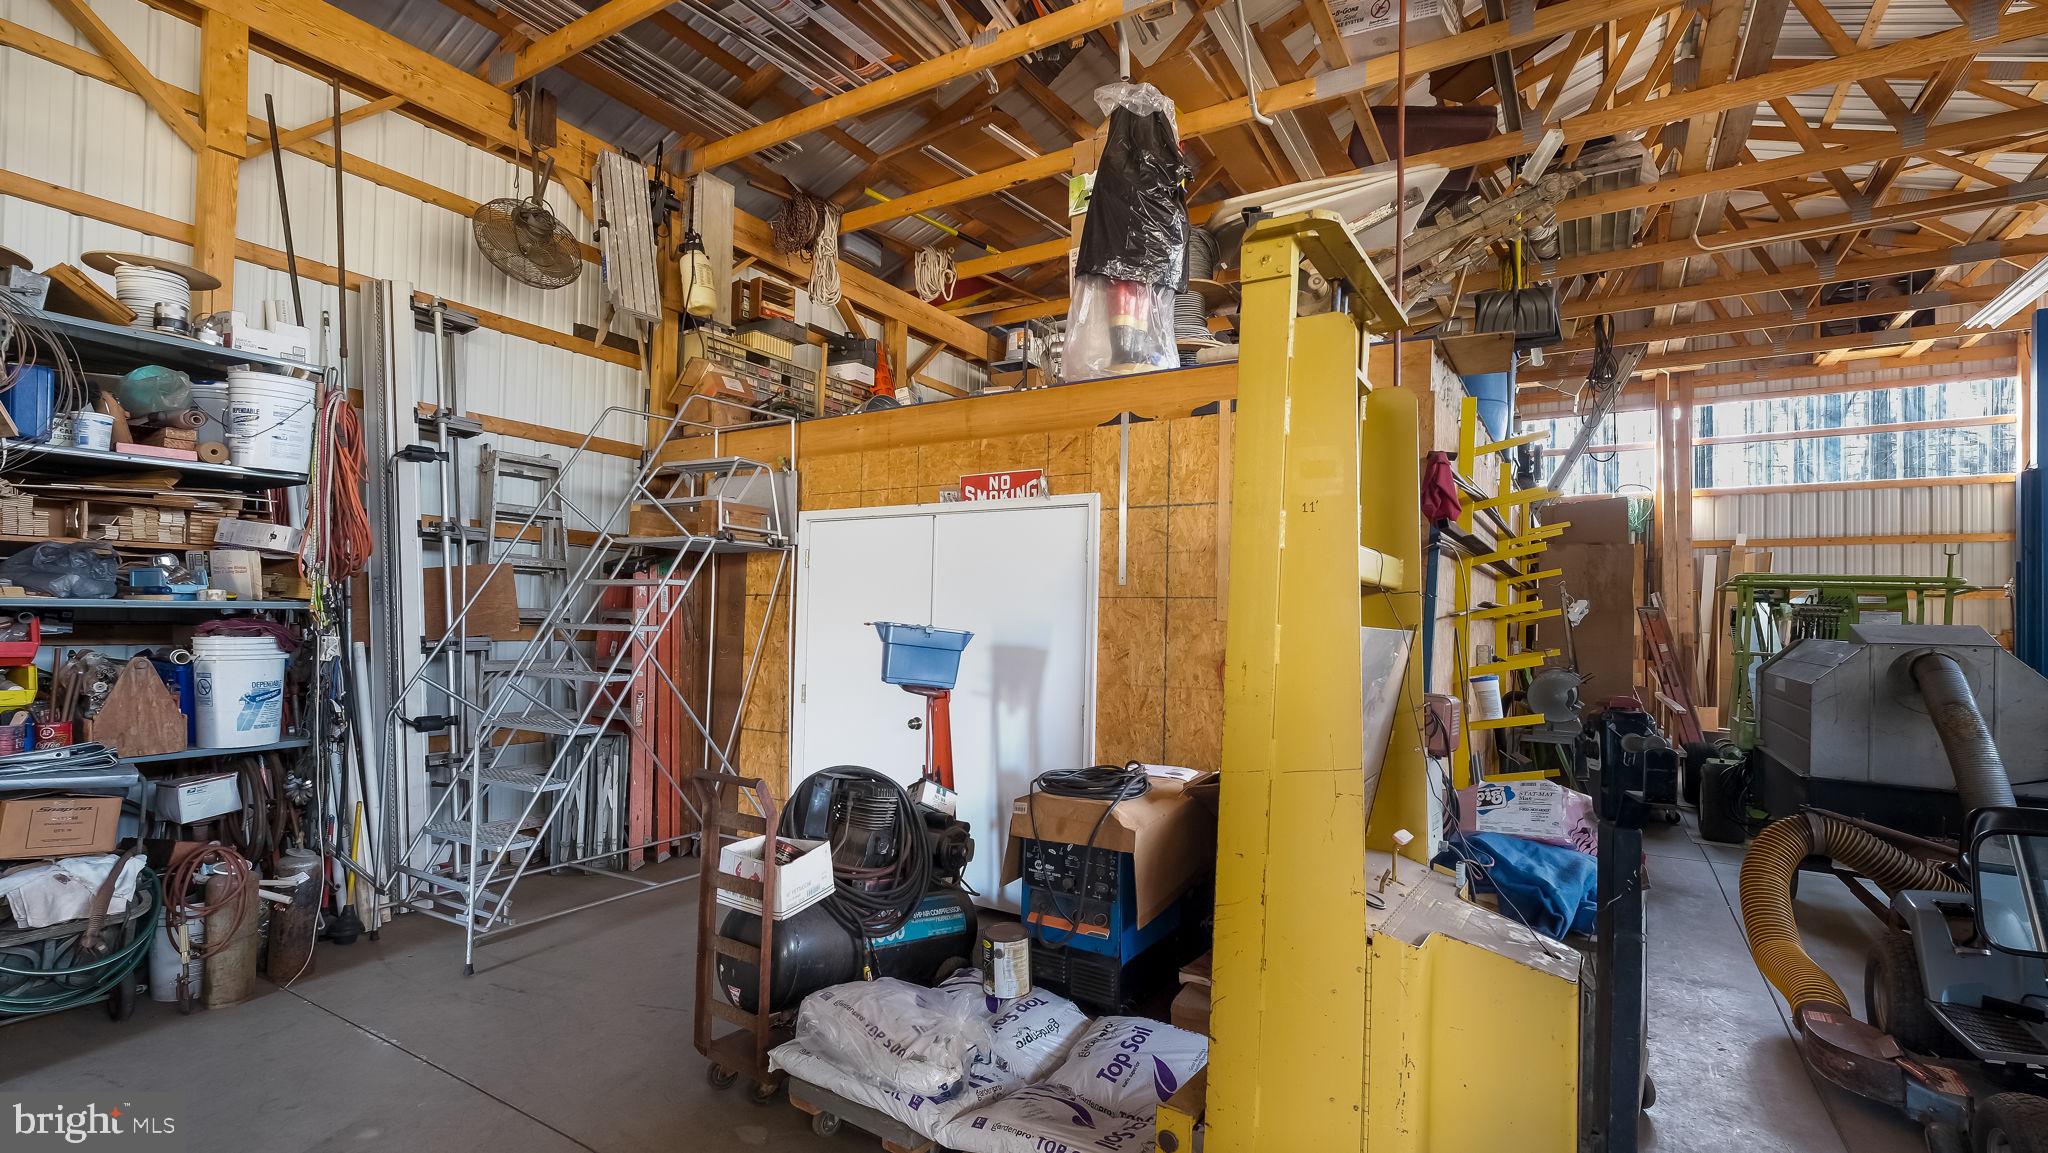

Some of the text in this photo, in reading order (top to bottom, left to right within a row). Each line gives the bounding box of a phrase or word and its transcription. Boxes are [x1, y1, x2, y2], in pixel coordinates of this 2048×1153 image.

[964, 478, 1038, 502] SMOKING
[989, 474, 1011, 491] NO
[930, 905, 961, 916] COMPRESSOR
[1016, 997, 1050, 1013] Top
[1096, 1025, 1154, 1084] Top Soil
[991, 1121, 1032, 1139] gardenpro
